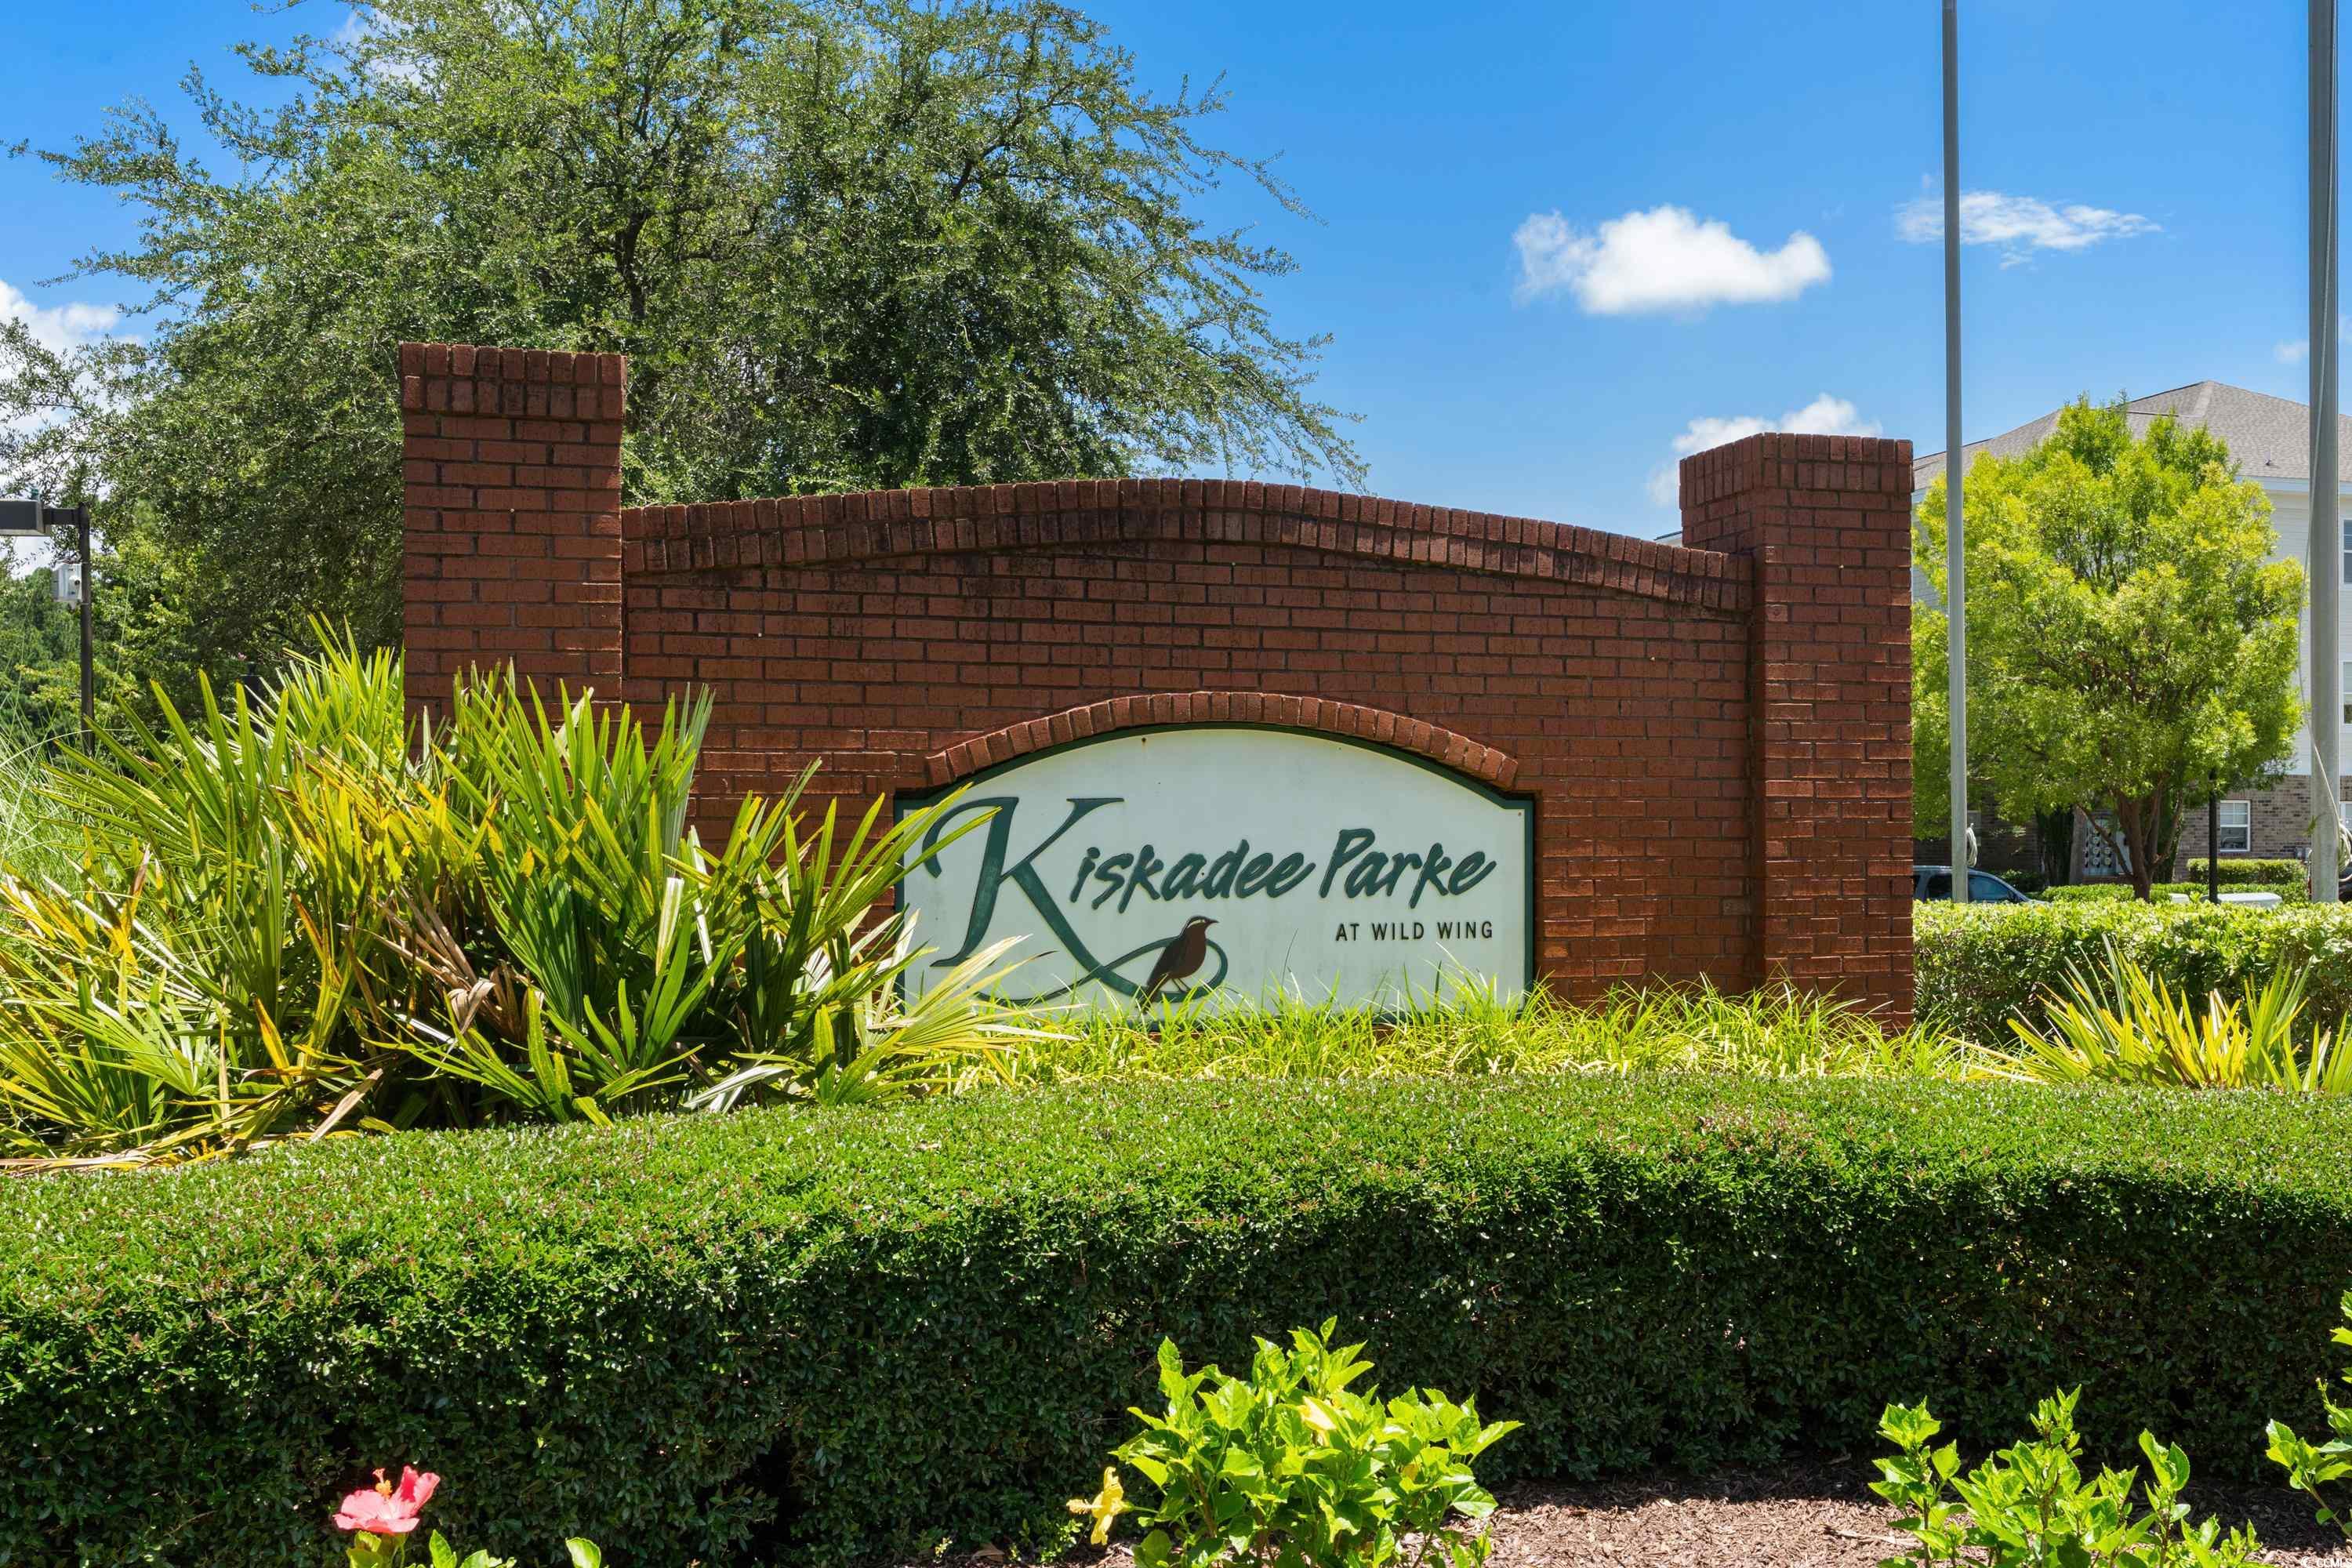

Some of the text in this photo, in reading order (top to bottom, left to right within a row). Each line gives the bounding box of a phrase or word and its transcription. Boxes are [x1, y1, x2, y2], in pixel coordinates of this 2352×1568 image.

[922, 797, 1497, 1004] Kiskadee Parke
[1335, 920, 1494, 942] AT WILD WING
